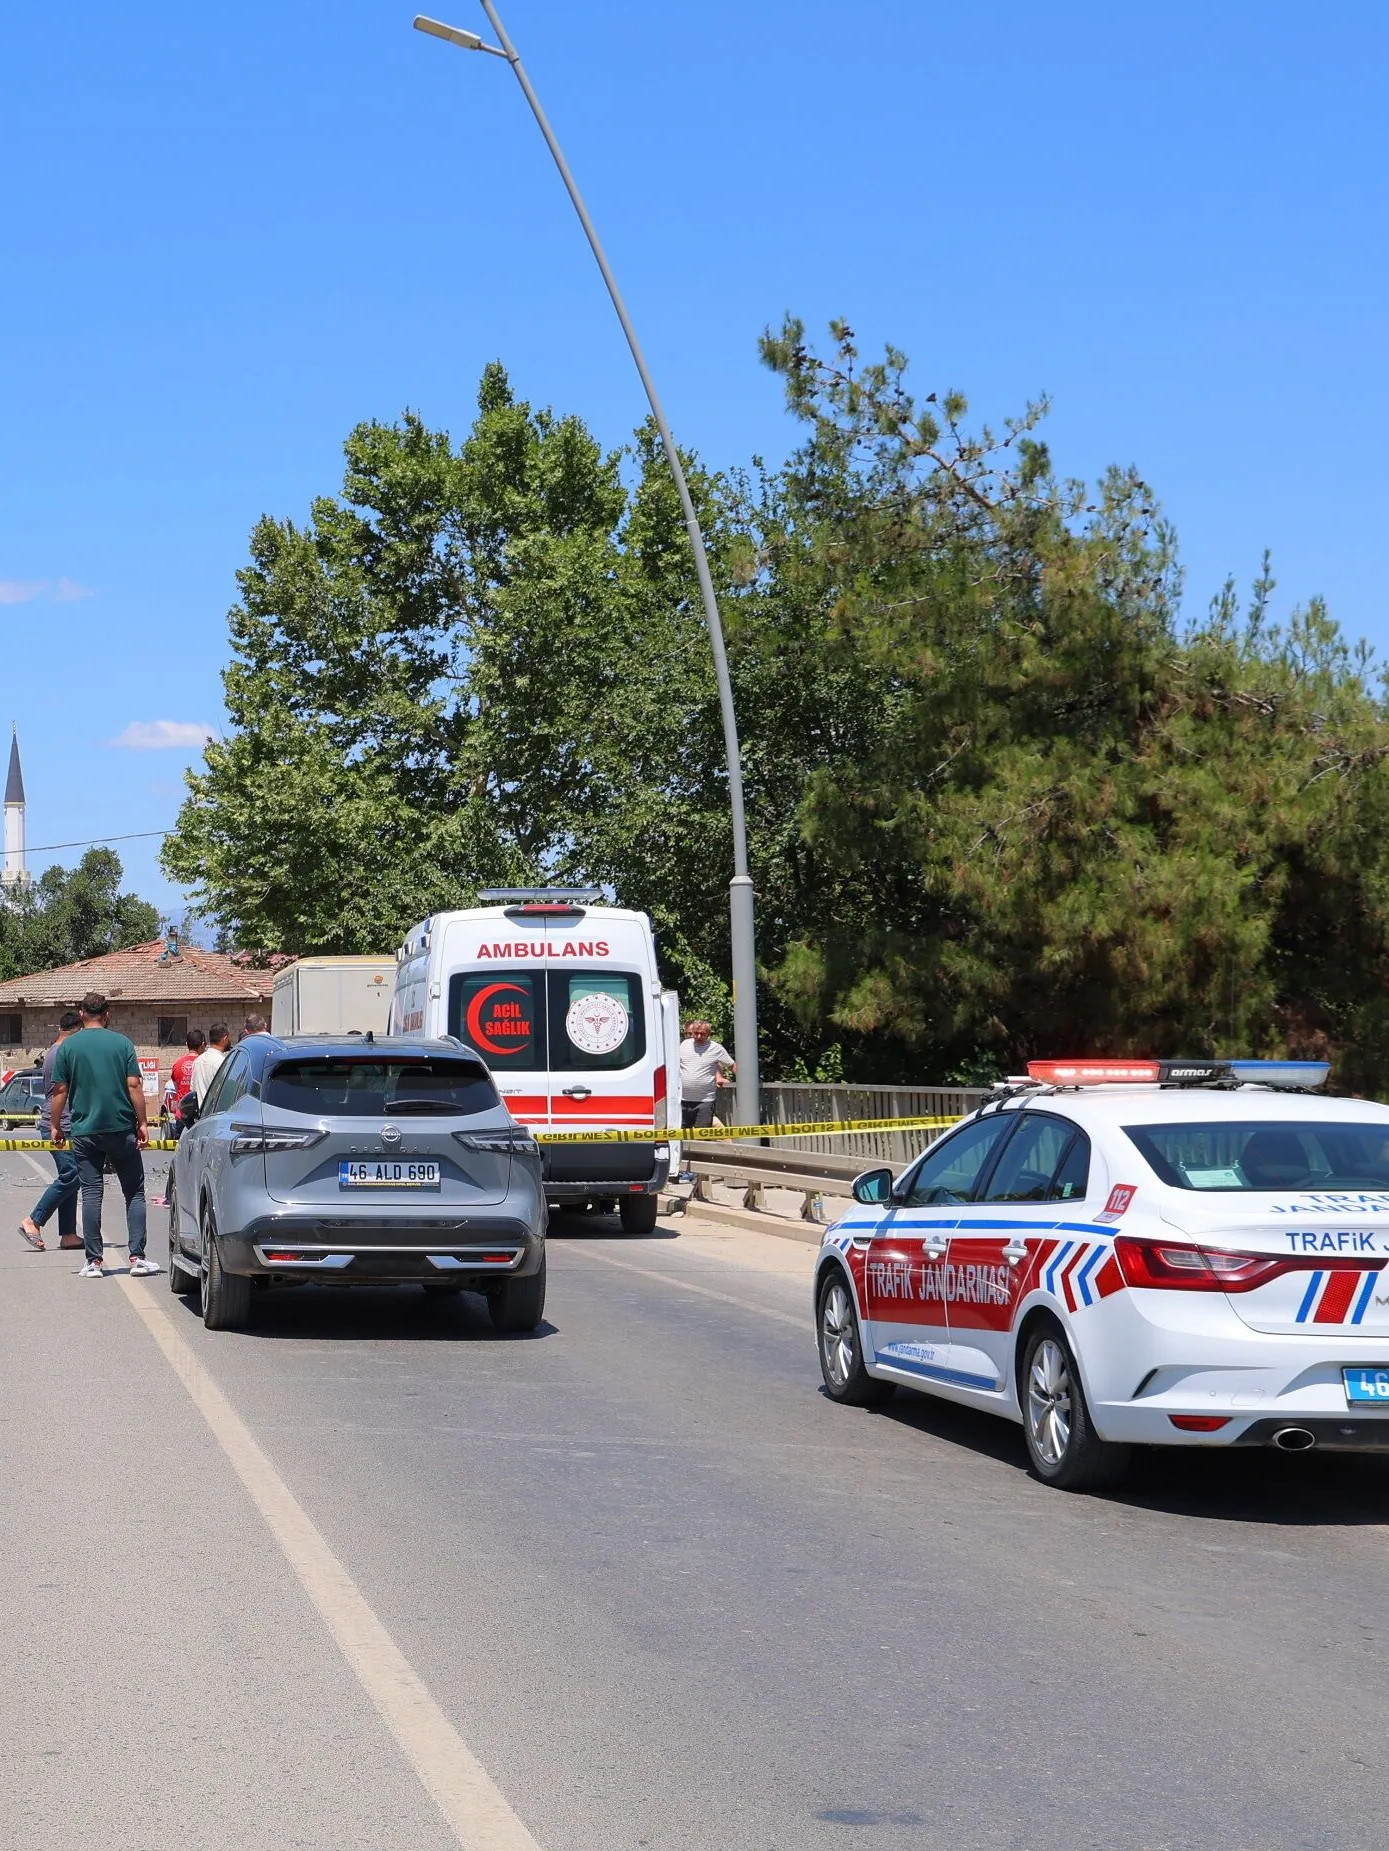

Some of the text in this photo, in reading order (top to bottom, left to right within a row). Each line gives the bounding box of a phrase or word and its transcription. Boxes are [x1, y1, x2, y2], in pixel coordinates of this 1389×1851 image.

[477, 942, 609, 959] AMBULANS
[493, 1002, 522, 1018] ACİL
[485, 1019, 530, 1036] SAĞLIK
[1171, 1069, 1212, 1077] armas
[350, 1165, 367, 1180] 46
[376, 1165, 401, 1180] ALD
[408, 1165, 435, 1180] 690
[1109, 1189, 1130, 1210] 112
[918, 1263, 1011, 1305] JANDARMASI
[1360, 1372, 1389, 1397] 46
